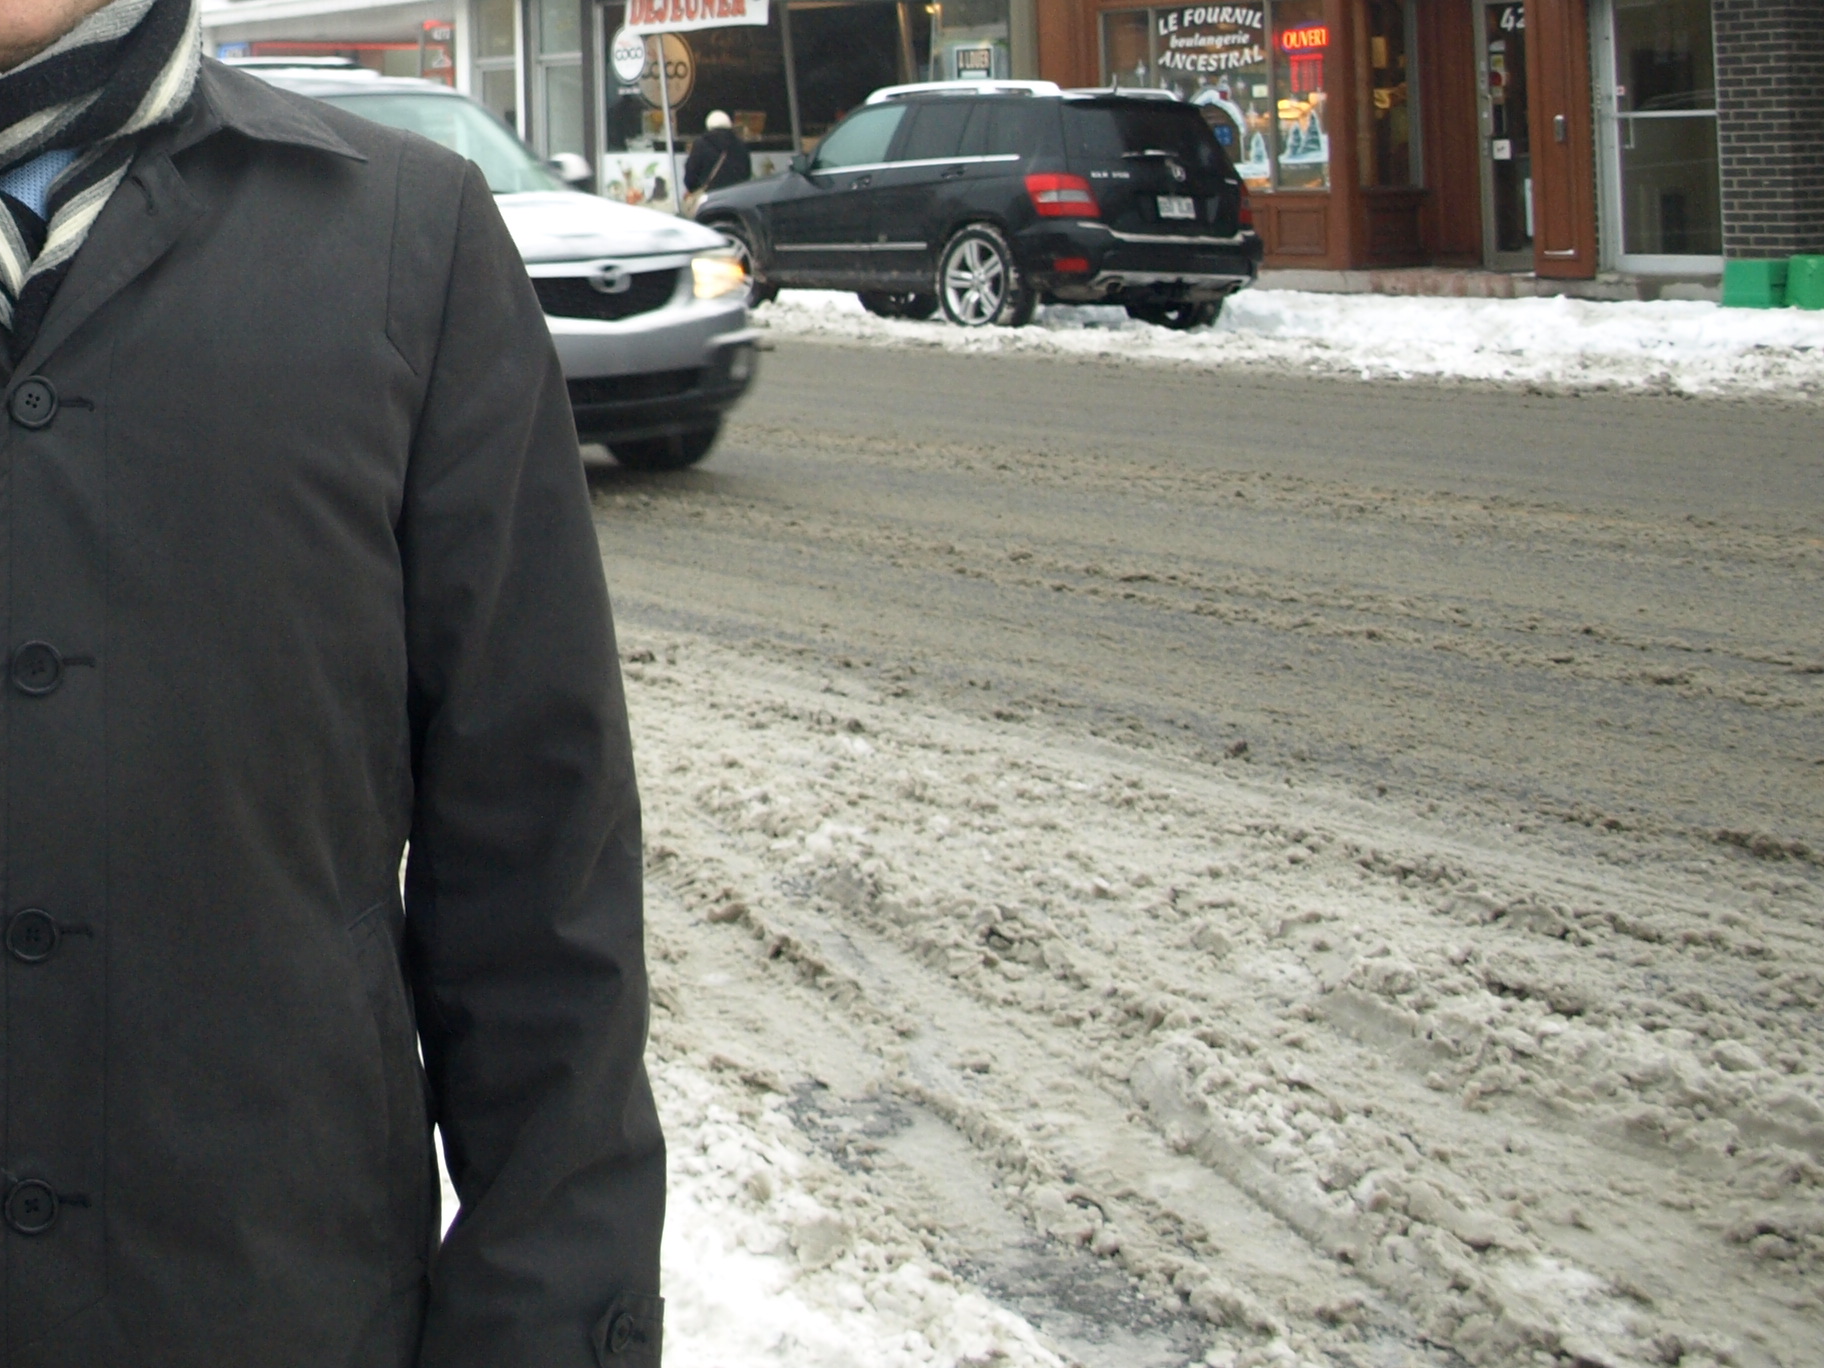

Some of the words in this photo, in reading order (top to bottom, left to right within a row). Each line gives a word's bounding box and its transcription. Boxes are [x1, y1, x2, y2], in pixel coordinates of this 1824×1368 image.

[1158, 12, 1179, 36] LE
[1183, 6, 1263, 29] FOURNIL
[1169, 30, 1251, 49] boulangerie
[1282, 27, 1328, 49] OUVERT
[1158, 44, 1264, 72] ANCESTRAL
